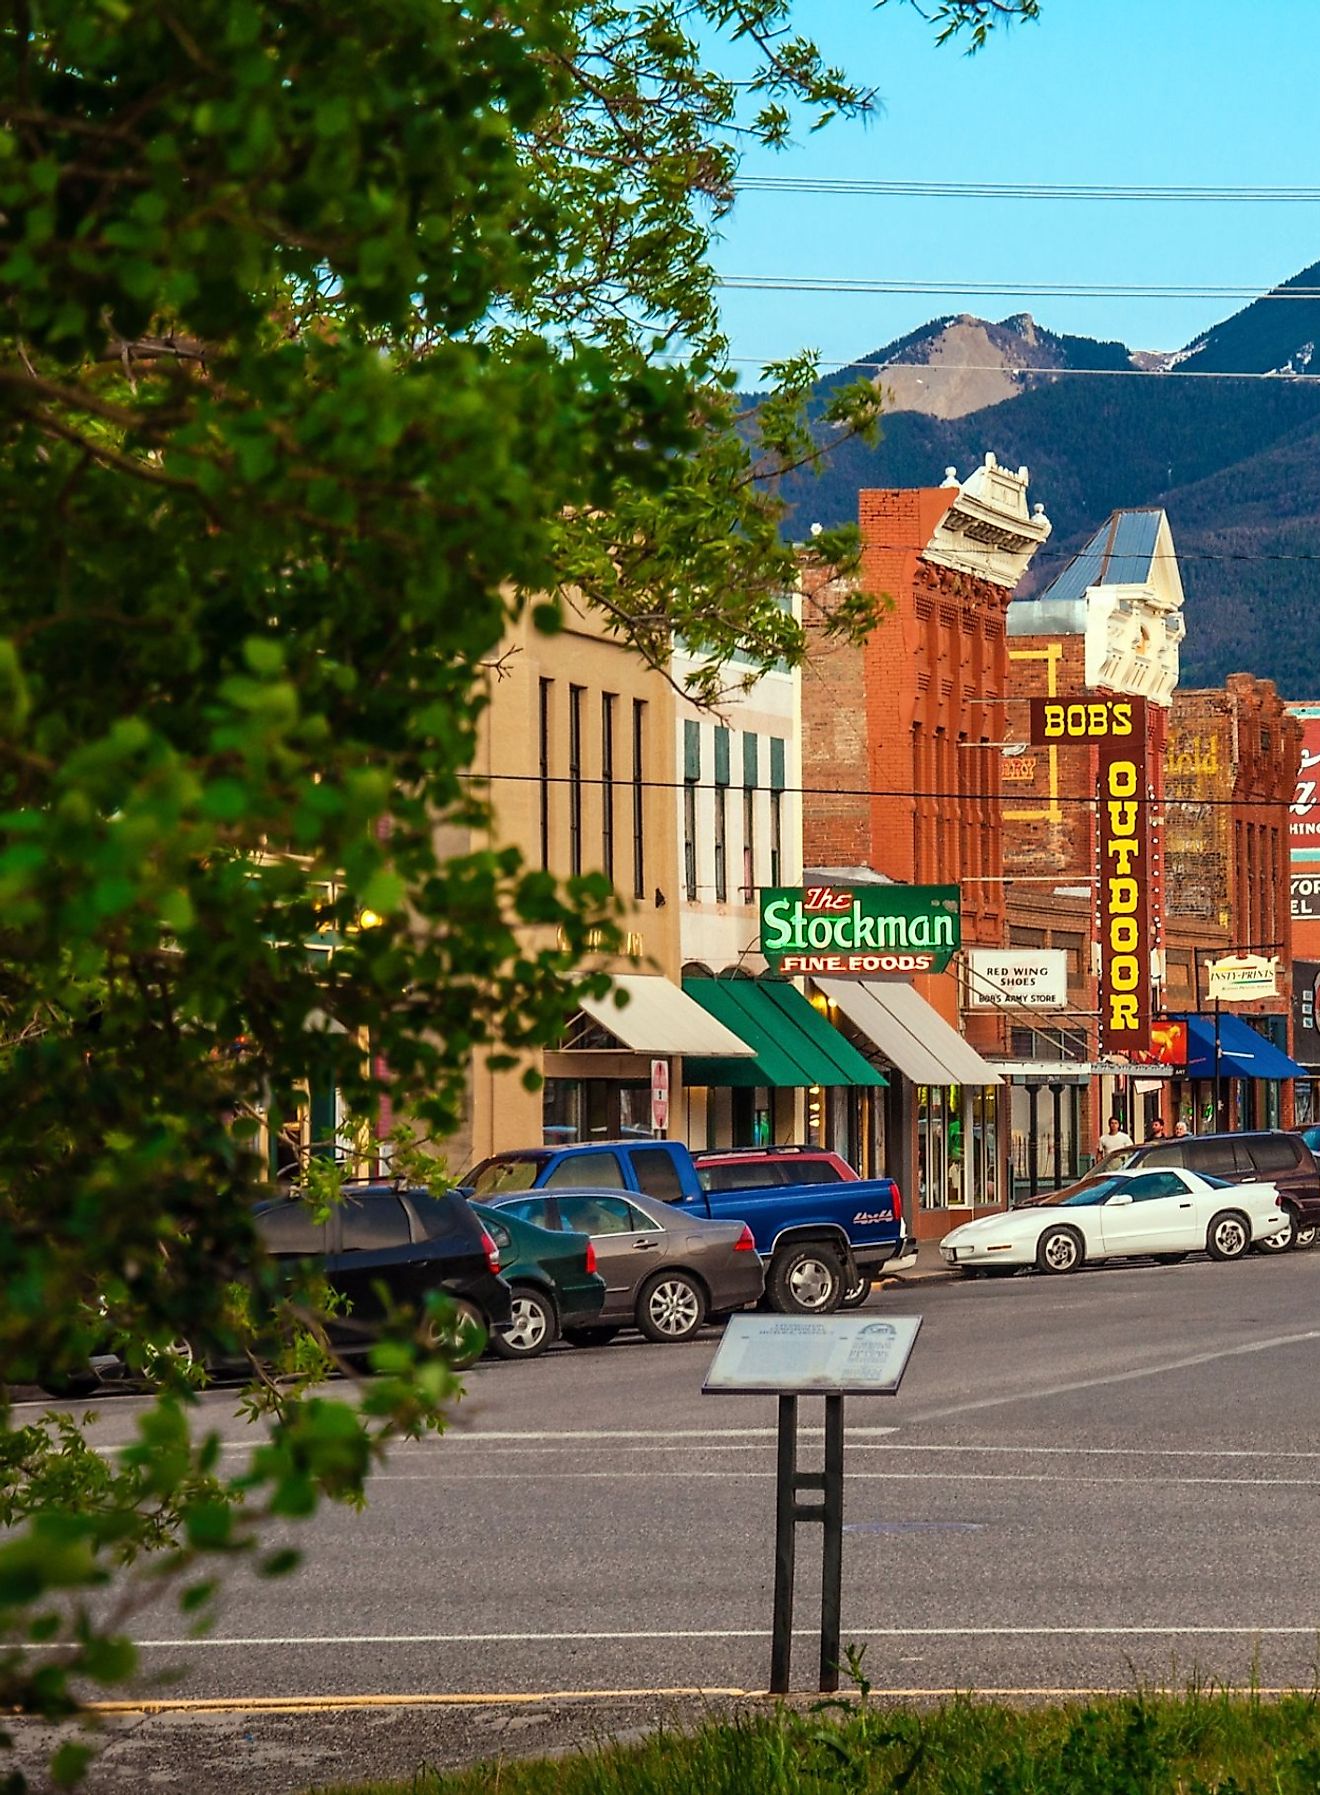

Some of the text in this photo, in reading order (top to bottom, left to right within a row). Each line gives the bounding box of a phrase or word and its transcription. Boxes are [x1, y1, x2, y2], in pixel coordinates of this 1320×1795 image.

[1044, 702, 1132, 737] BOB'S
[804, 887, 852, 910] The
[1107, 761, 1139, 1030] OUTDOOR
[763, 897, 955, 949] Stockman
[780, 956, 934, 971] FINE FOODS
[986, 967, 1048, 976] RED WING
[1000, 977, 1036, 986] SHOES
[978, 994, 1056, 1002] BOB'S ARMY STORE
